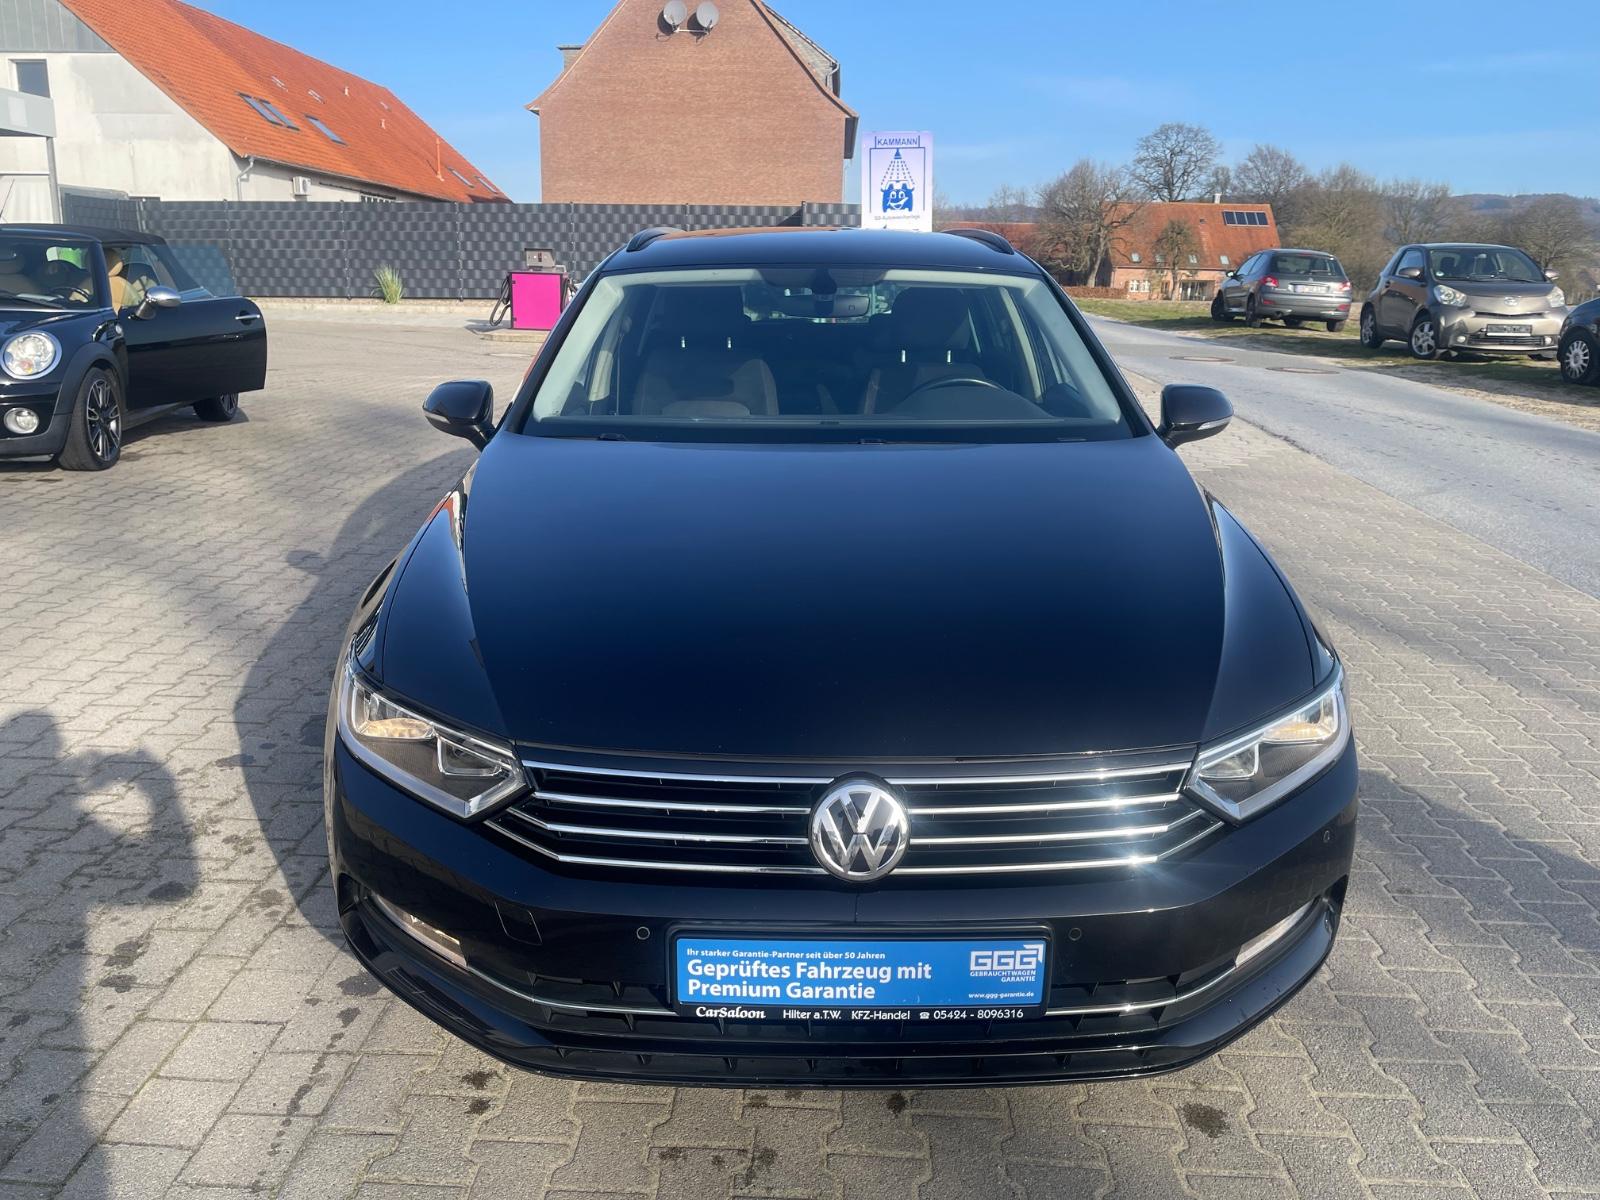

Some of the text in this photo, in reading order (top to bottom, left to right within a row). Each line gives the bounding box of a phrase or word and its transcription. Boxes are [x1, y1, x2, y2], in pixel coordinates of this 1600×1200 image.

[877, 137, 918, 146] KAMMANN
[811, 783, 910, 881] VW
[686, 948, 699, 956] Ihr
[700, 949, 731, 957] starker
[732, 950, 804, 959] Garantie-Partner
[805, 951, 822, 959] seit
[823, 951, 842, 959] über
[856, 952, 886, 960] Jahren
[970, 950, 1038, 971] GGG
[687, 958, 932, 984] Geprüftes Fahrzeug mit
[688, 979, 876, 999] Premium Garantie
[968, 991, 1035, 999] www.ggg-garantie.de
[695, 1006, 766, 1019] CarSaloon
[783, 1009, 812, 1019] Hilter
[813, 1010, 842, 1020] a.T.W.
[851, 1010, 911, 1020] KFZ-Handel
[933, 1010, 967, 1019] 05424
[977, 1009, 1024, 1019] 8096316
